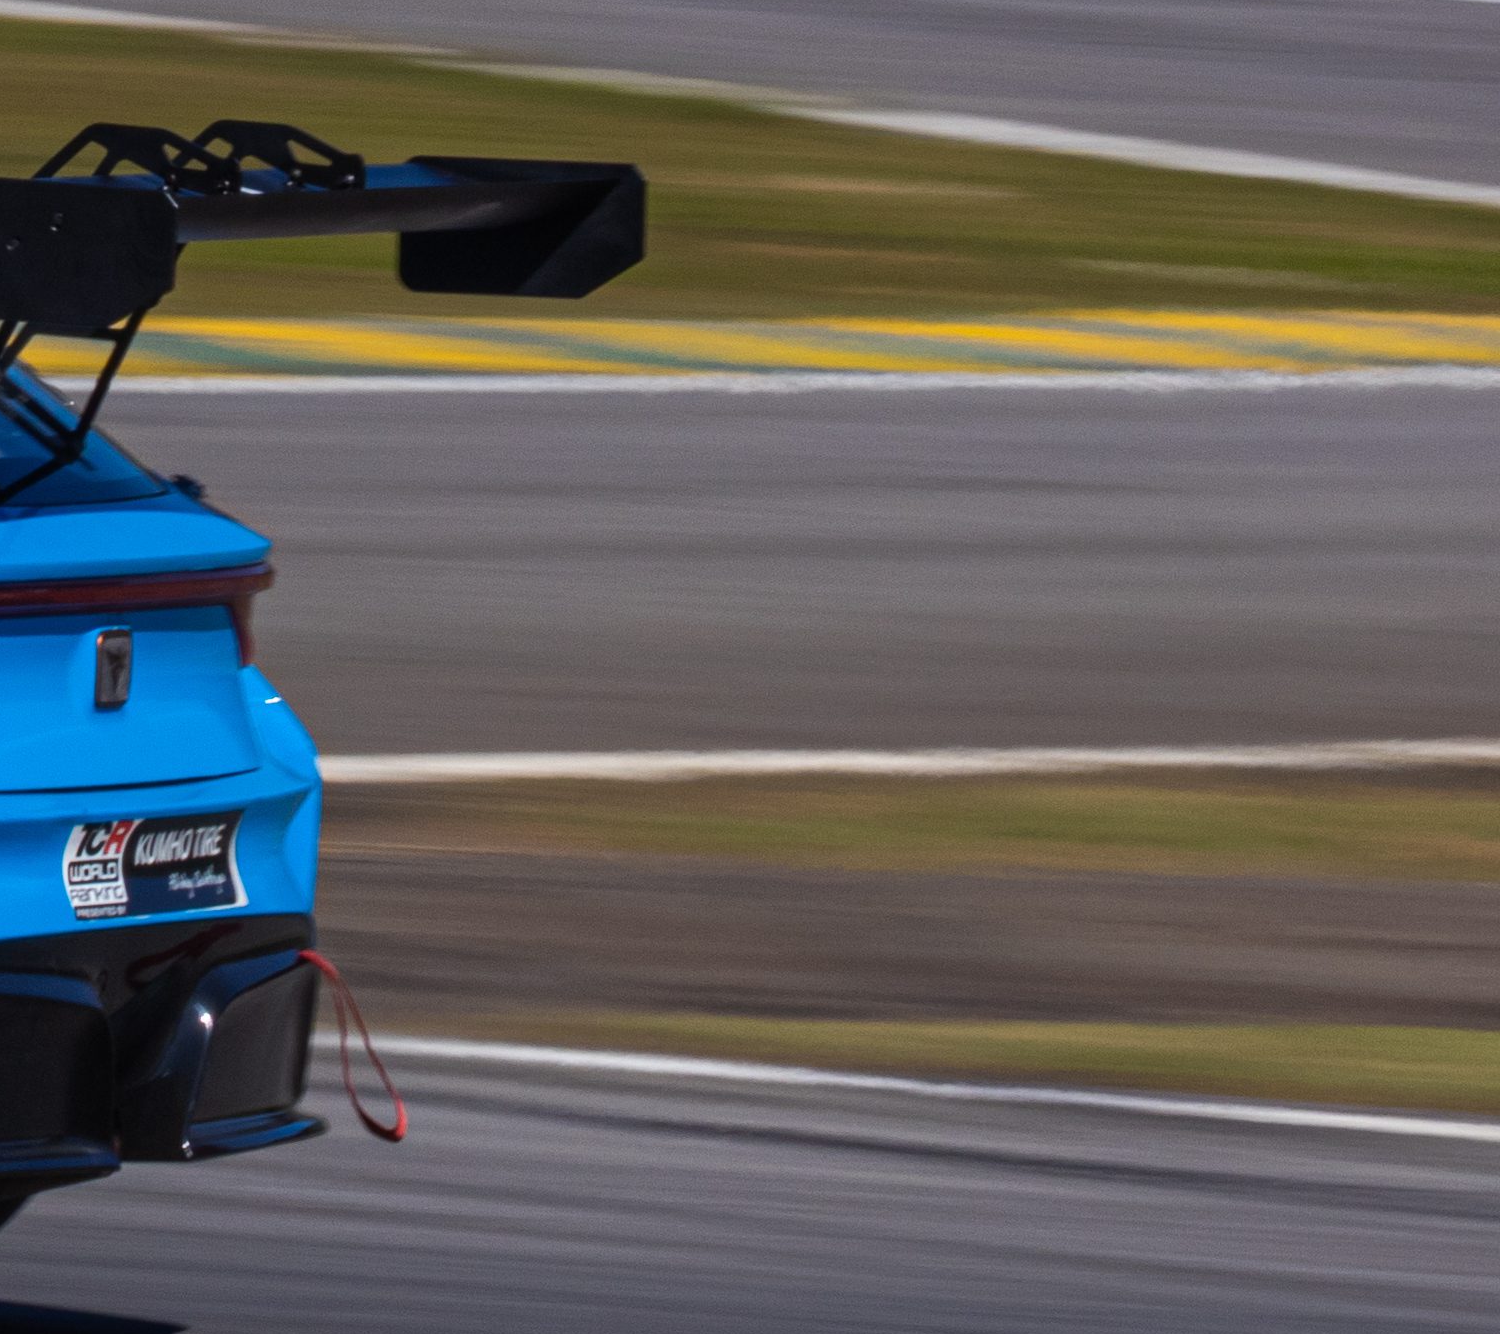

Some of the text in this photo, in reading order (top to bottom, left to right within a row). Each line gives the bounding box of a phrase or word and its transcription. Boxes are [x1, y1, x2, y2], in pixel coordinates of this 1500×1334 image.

[76, 820, 135, 858] TCR
[134, 823, 227, 866] KUMHO TIRE
